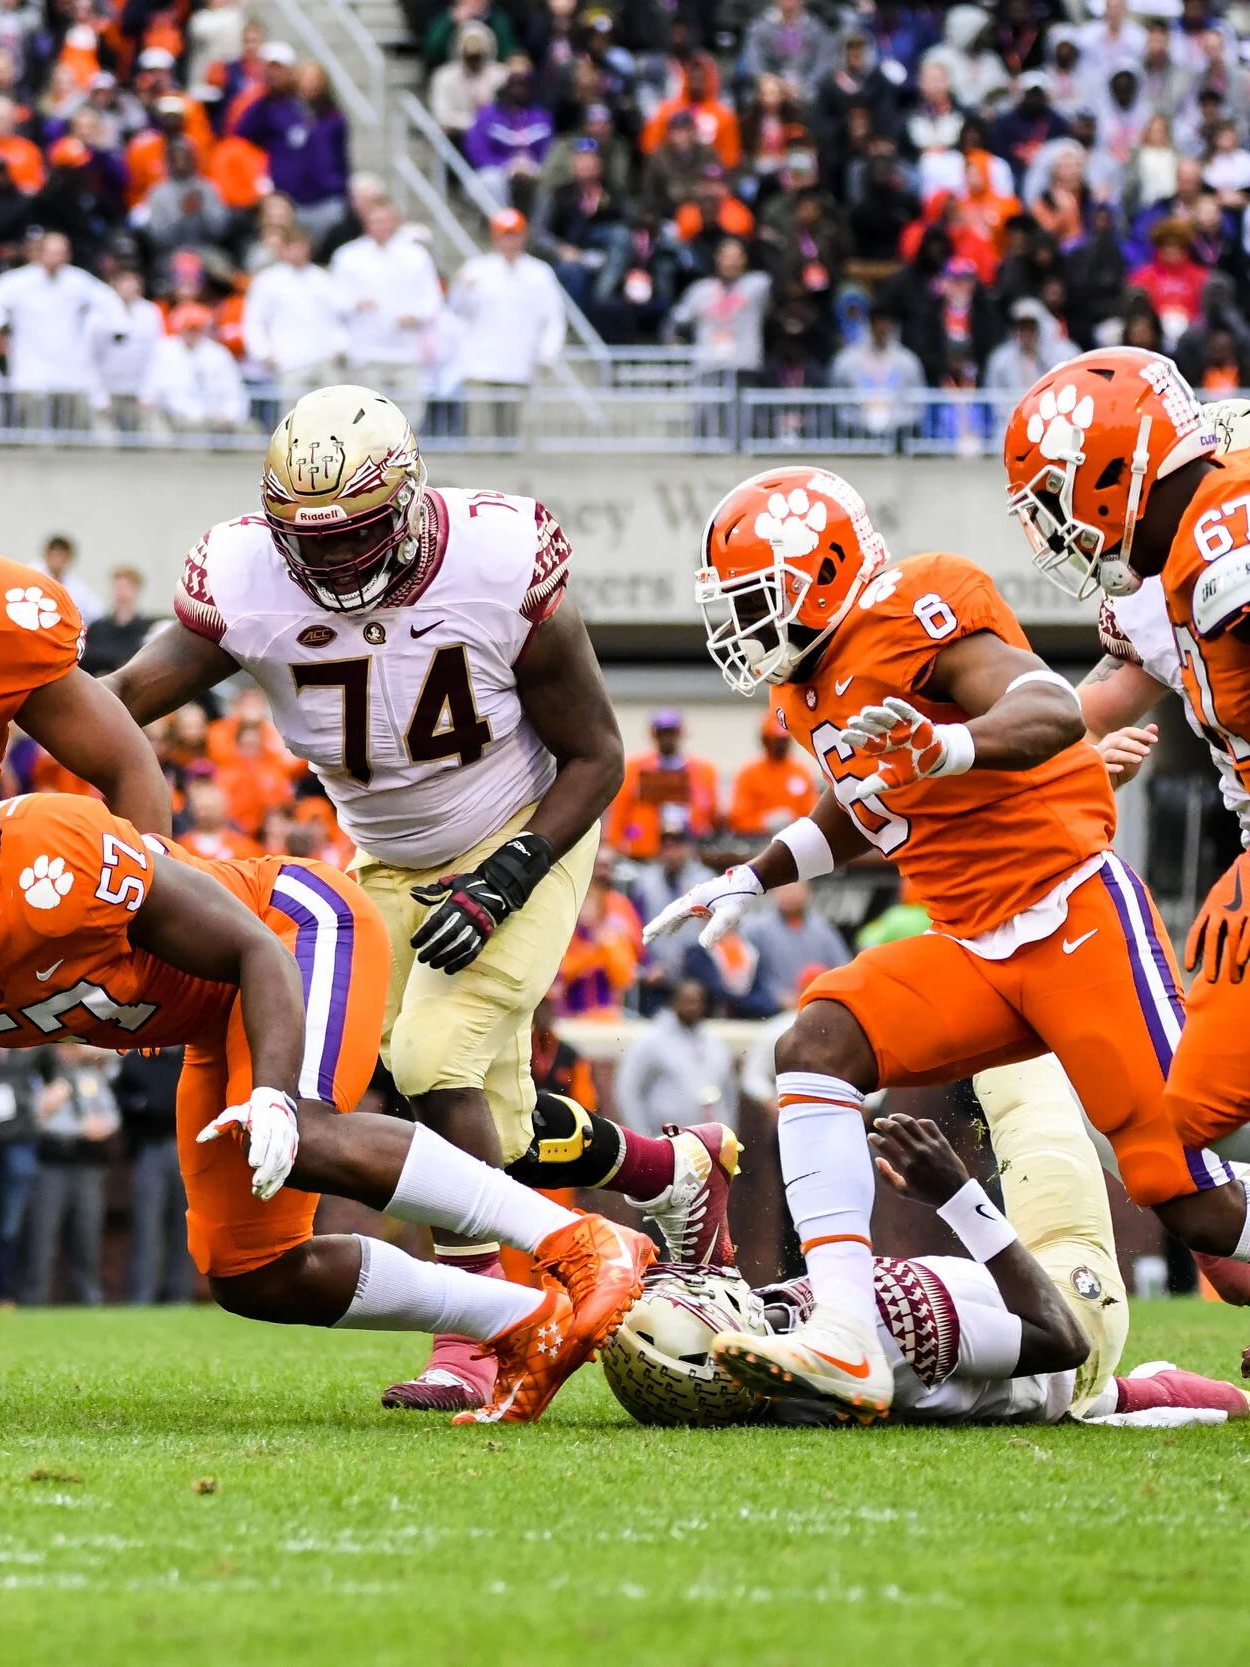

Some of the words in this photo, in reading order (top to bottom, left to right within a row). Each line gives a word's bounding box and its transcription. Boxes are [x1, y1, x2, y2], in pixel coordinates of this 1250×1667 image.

[300, 509, 339, 521] Riddell
[303, 629, 330, 641] ACC
[913, 592, 958, 640] 6
[289, 643, 494, 787] 74
[810, 719, 912, 858] 6
[96, 832, 148, 912] 57
